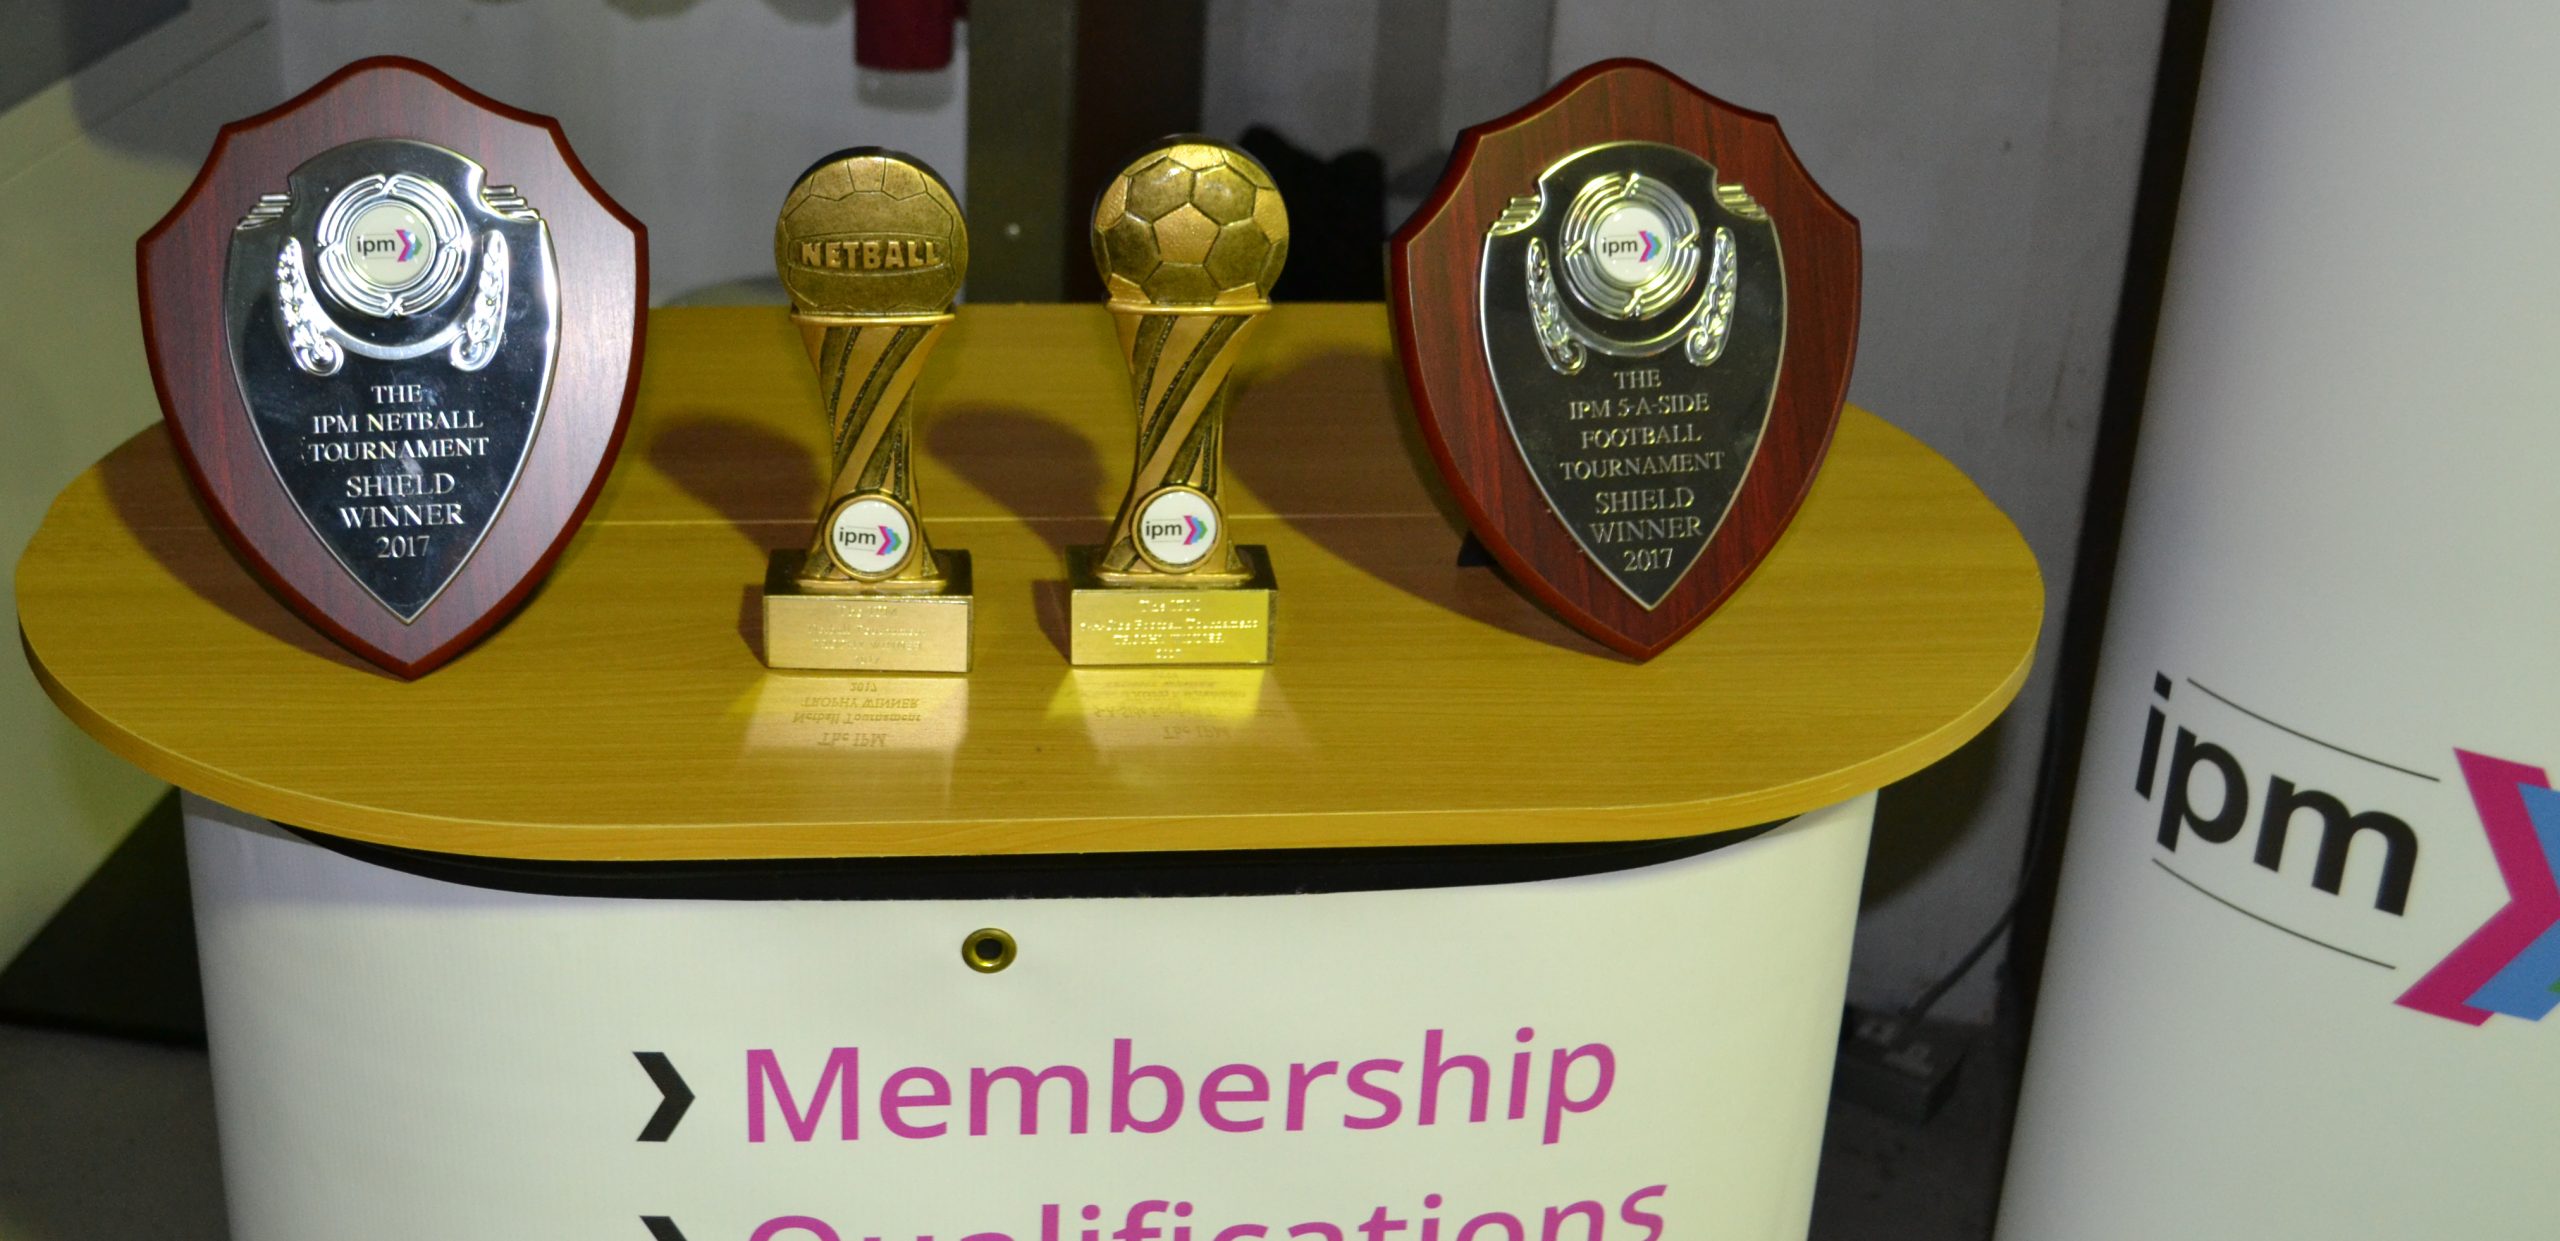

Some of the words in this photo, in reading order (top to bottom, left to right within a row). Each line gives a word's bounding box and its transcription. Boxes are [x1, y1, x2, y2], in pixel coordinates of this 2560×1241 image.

[357, 236, 395, 256] ipm
[801, 240, 940, 269] NETBALL
[1603, 237, 1638, 258] ipm
[1613, 369, 1662, 390] THE
[371, 384, 423, 404] THE
[1569, 399, 1611, 420] IPM
[1617, 393, 1711, 417] 5-A-SIDE
[313, 414, 359, 434] IPM
[367, 410, 484, 432] NETBALL
[1580, 423, 1702, 449] FOOTBALL
[308, 437, 489, 462] TOURNAMENT
[1560, 451, 1726, 481] TOURNAMENT
[346, 472, 456, 498] SHIELD
[1596, 486, 1695, 515] SHIELD
[339, 503, 466, 529] WINNER
[839, 526, 876, 546] ipm
[1146, 521, 1182, 540] ipm
[1589, 515, 1703, 544] WINNER
[376, 535, 430, 558] 2017
[1623, 548, 1674, 572] 2017
[2134, 670, 2419, 917] ipm
[745, 1027, 1617, 1145] Membership
